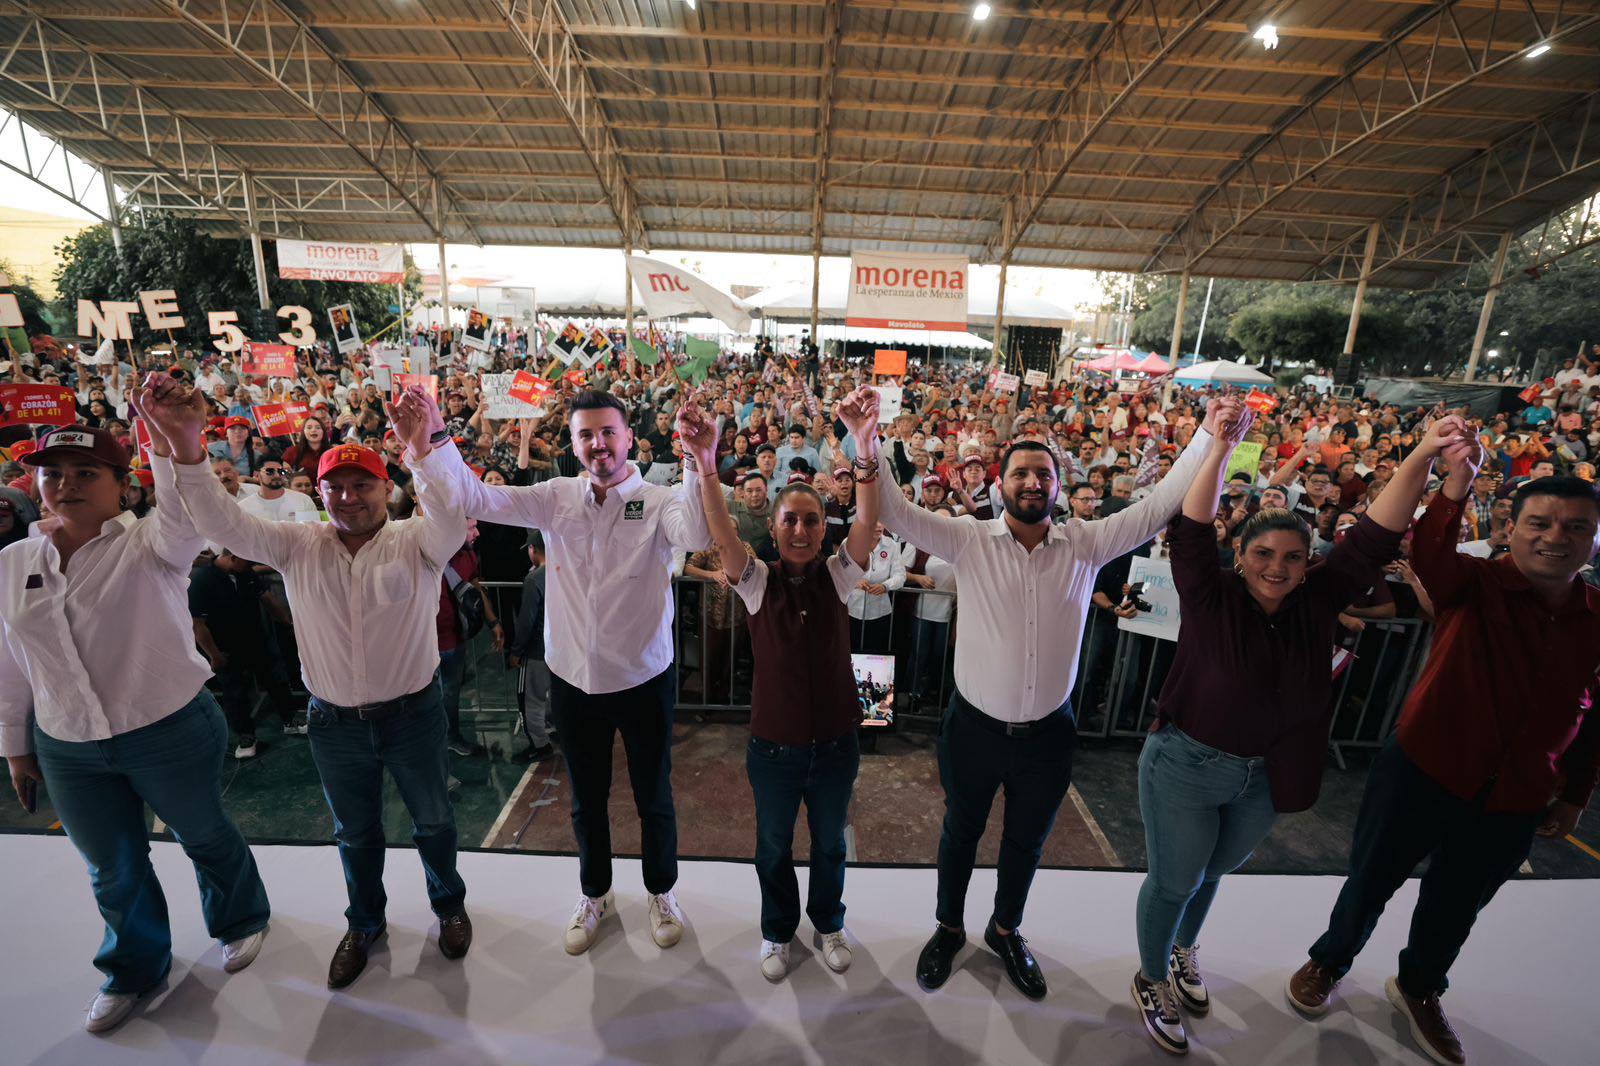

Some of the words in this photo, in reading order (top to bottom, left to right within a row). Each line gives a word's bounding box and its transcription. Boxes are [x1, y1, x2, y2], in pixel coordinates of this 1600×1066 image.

[307, 245, 378, 261] morena
[310, 269, 379, 282] NAVOLATO
[856, 266, 964, 289] morena
[856, 286, 867, 295] La
[868, 288, 915, 298] esperanza
[916, 289, 928, 297] de
[21, 400, 58, 409] CORAZÓN
[17, 410, 29, 418] DE
[32, 409, 44, 417] LA
